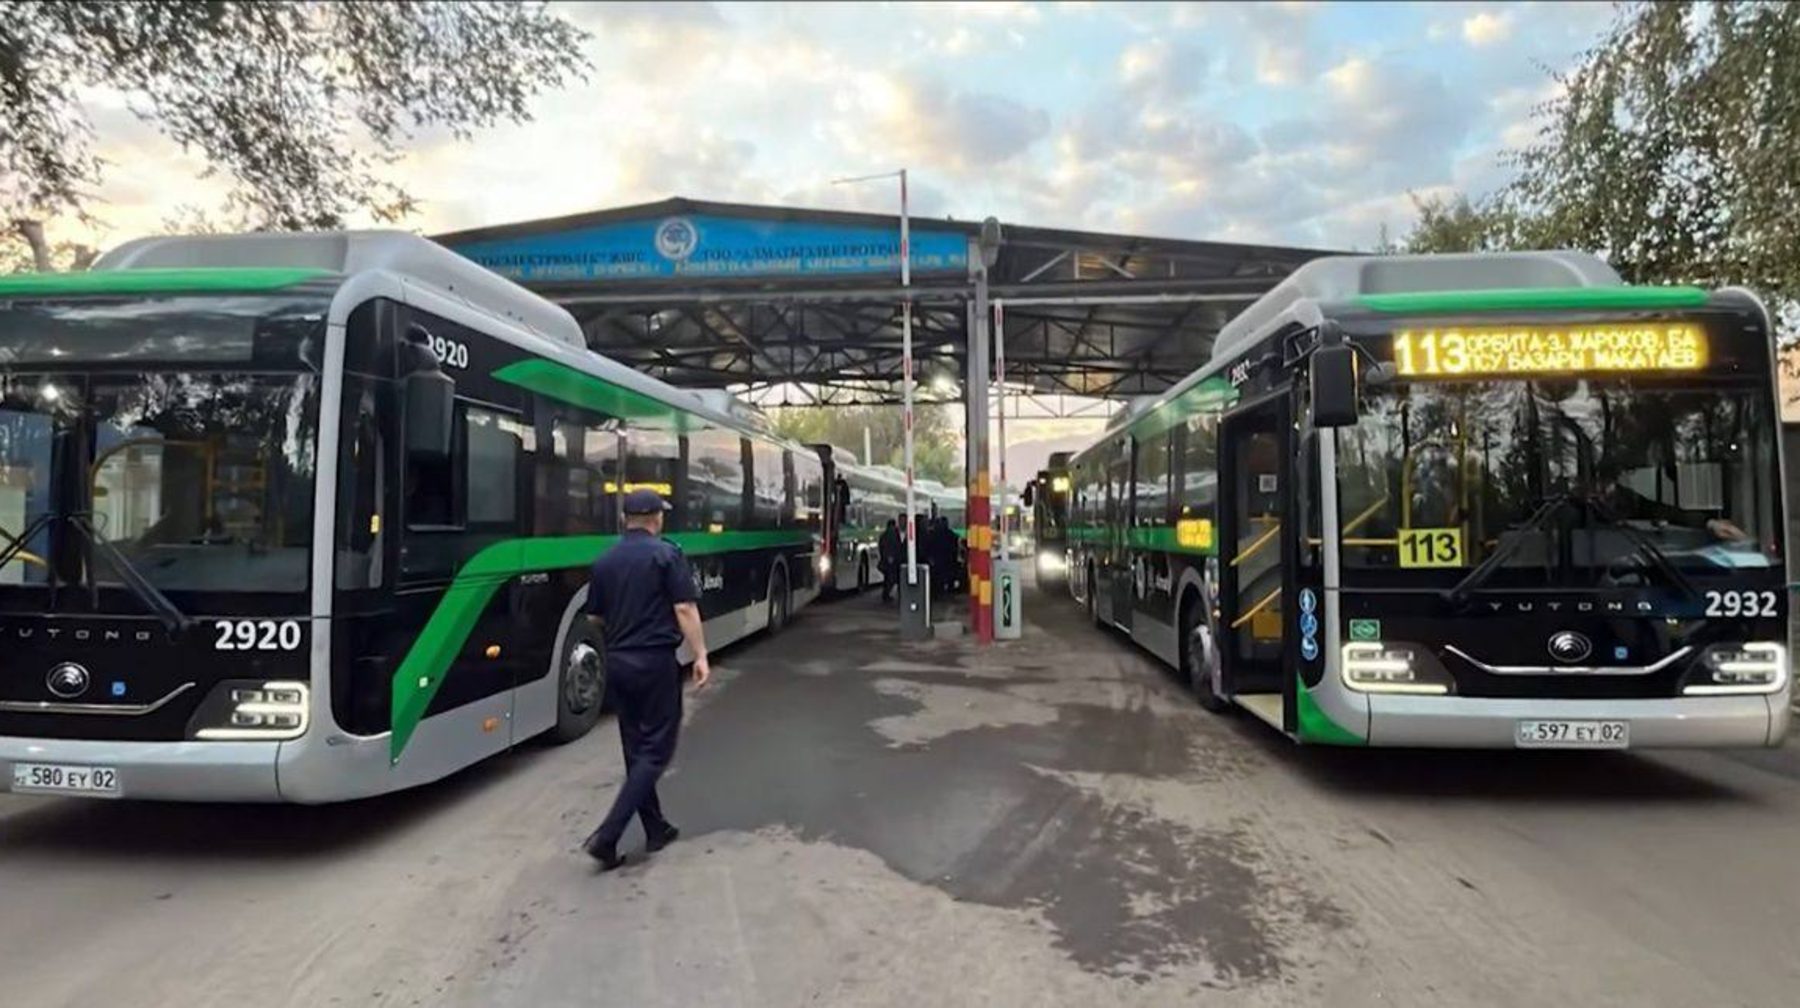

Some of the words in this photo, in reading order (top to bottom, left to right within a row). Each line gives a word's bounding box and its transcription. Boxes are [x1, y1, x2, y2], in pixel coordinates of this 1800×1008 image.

[1668, 329, 1697, 348] БА
[1394, 332, 1466, 375] 113
[1508, 350, 1585, 371] БАЗАРЫ
[1594, 348, 1698, 369] МАКАТАЕВ
[1403, 532, 1457, 563] 113
[1489, 602, 1652, 611] YUTONG
[1705, 590, 1777, 617] 2932
[0, 627, 150, 640] UTONG
[215, 620, 301, 650] 2920
[1538, 723, 1569, 739] 597
[1577, 727, 1596, 740] EY
[1602, 723, 1623, 740] 02
[32, 767, 62, 785] 580
[68, 772, 88, 787] EY
[93, 770, 115, 787] 02
